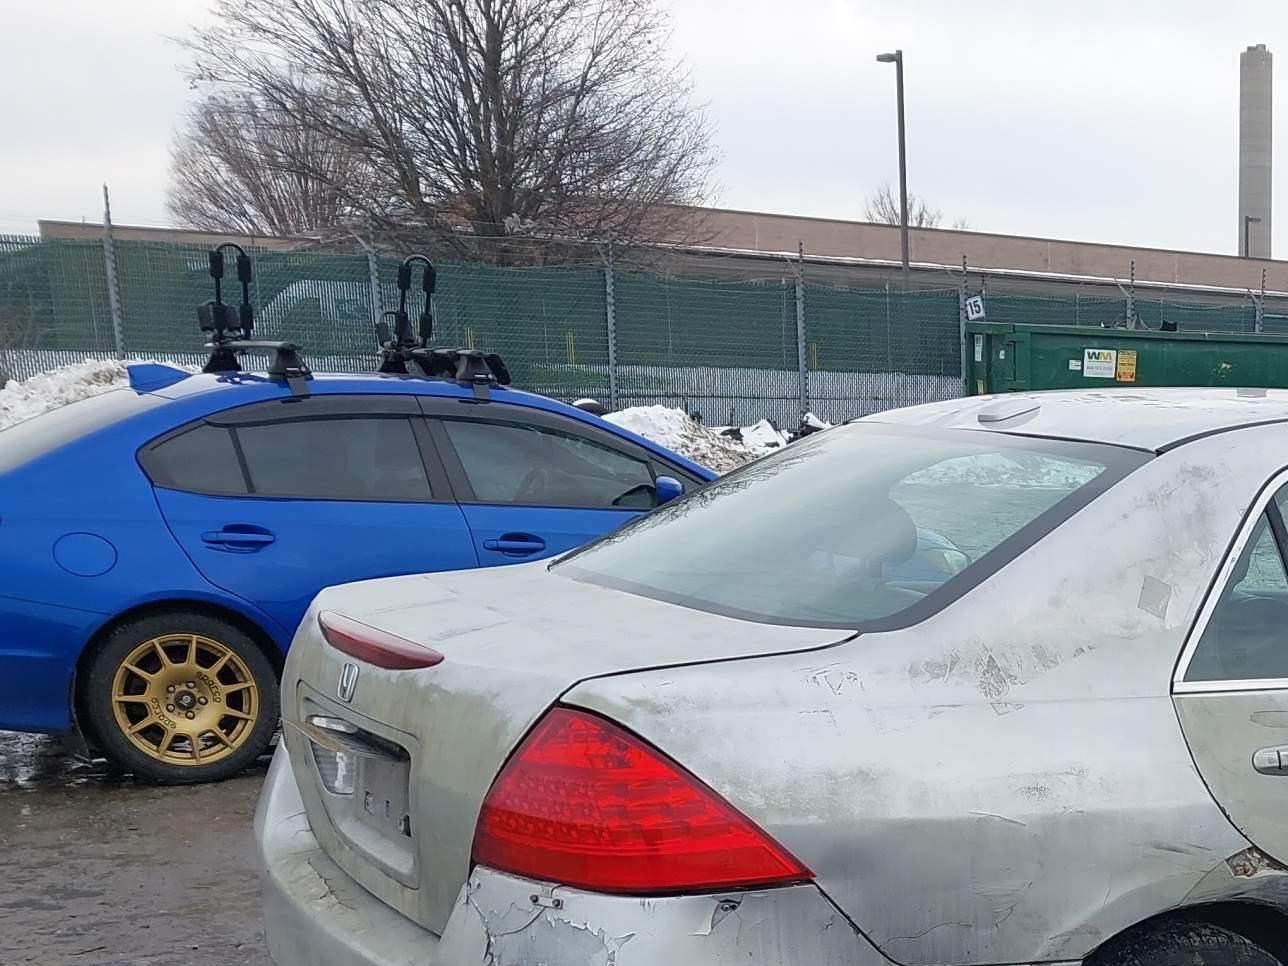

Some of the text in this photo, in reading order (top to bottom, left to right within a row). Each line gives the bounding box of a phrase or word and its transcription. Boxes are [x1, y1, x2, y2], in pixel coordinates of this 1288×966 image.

[968, 300, 982, 316] 15
[1087, 351, 1112, 361] WM
[196, 671, 221, 703] sparco
[151, 697, 176, 729] sparco
